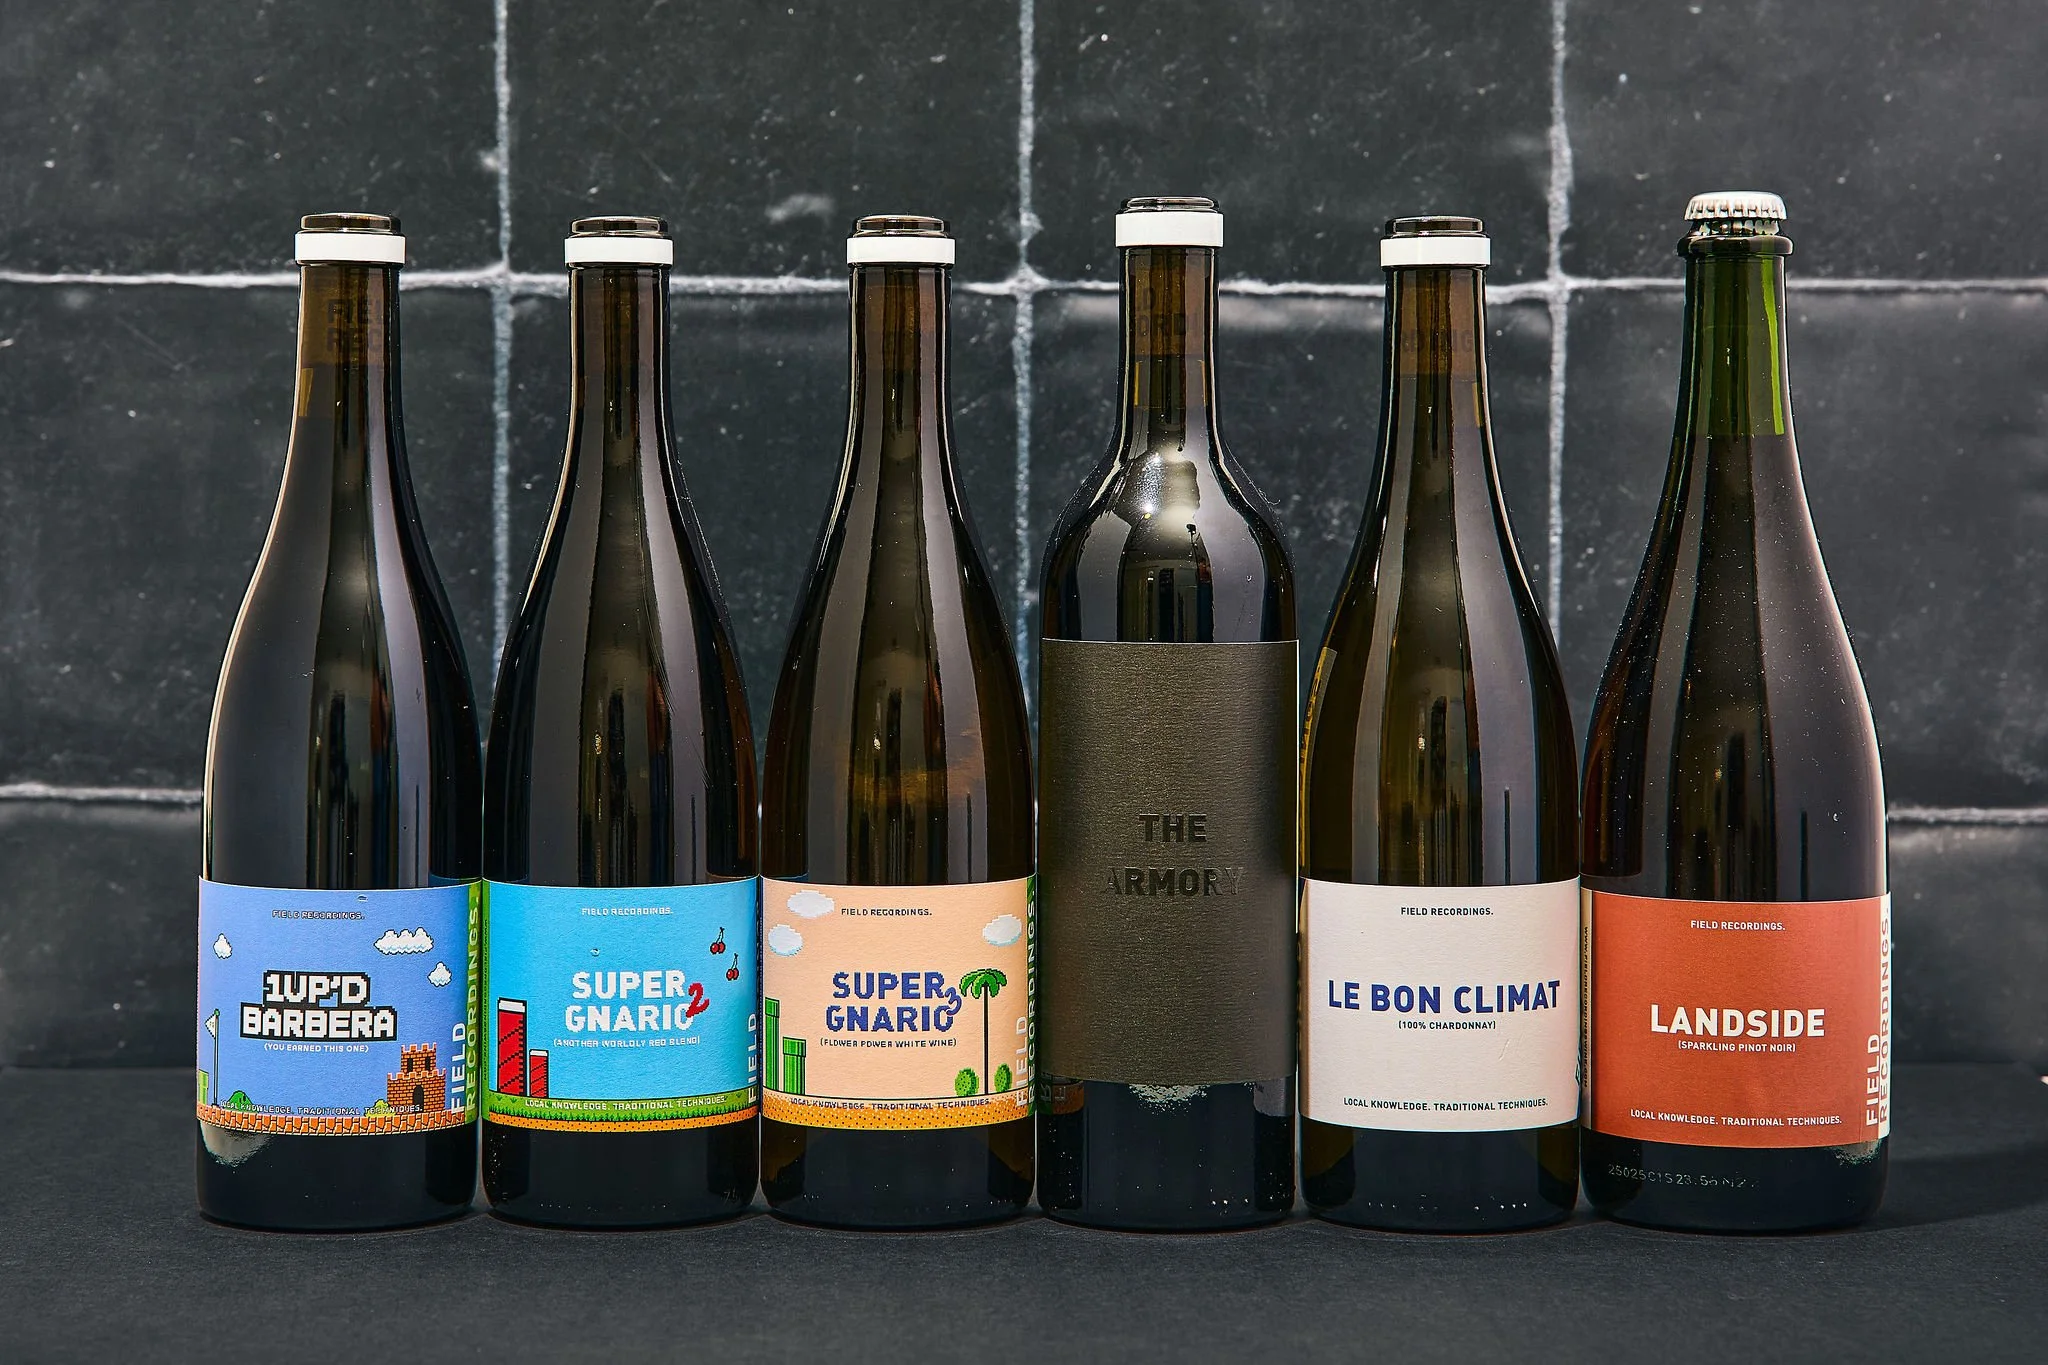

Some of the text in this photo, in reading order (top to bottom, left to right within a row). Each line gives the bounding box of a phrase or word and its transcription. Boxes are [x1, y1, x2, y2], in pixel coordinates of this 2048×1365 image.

[1139, 813, 1207, 843] THE
[1105, 866, 1243, 896] ARMORY
[581, 908, 609, 916] FIELD
[841, 908, 933, 917] FIELD RECORDINGS.
[1401, 907, 1494, 916] FIELD RECORDINGS.
[1691, 920, 1786, 931] FIELD RECORDINGS.
[572, 970, 686, 1000] SUPER
[833, 971, 945, 999] SUPER
[1028, 890, 1036, 1104] RECORDINGS.
[1328, 979, 1560, 1014] LE BON CLIMAT
[466, 897, 479, 1110] RECORDINGS.
[565, 982, 710, 1033] GNARIO 2
[826, 987, 962, 1032] GNARIO 3
[1879, 907, 1890, 1125] RECORDINGS.
[241, 1005, 396, 1039] BARBERA
[1398, 1020, 1496, 1030] (100% CHARDONNAY)
[1650, 1004, 1825, 1038] LANDSIDE
[264, 1043, 369, 1053] (YOU EARNED THIS ONE)
[820, 1038, 858, 1048] (FLOWER
[895, 1040, 926, 1048] WHITE
[929, 1038, 957, 1047] WINE)
[1678, 1040, 1796, 1053] (SPARKLING PINOT NOIR)
[451, 1022, 466, 1114] FIELD
[748, 1013, 757, 1104] FIELD
[1016, 1016, 1027, 1107] FIELD
[1866, 1034, 1880, 1126] FIELD
[298, 1107, 360, 1116] TRADITIONAL
[364, 1104, 423, 1115] TECHNIQUES.
[525, 1099, 549, 1108] LOCAL
[552, 1101, 610, 1110] KNOWLEDGE.
[613, 1100, 674, 1110] TRADITIONAL
[872, 1102, 933, 1110] TRADITIONAL
[937, 1099, 991, 1109] TECHNIQUES.
[1343, 1097, 1548, 1111] LOCAL KNOWLEDGE. TRADITIONAL TECHNIQUES.
[1630, 1109, 1842, 1126] LOCAL KNOWLEDGE. TRADITIONAL TECHNIQUES.
